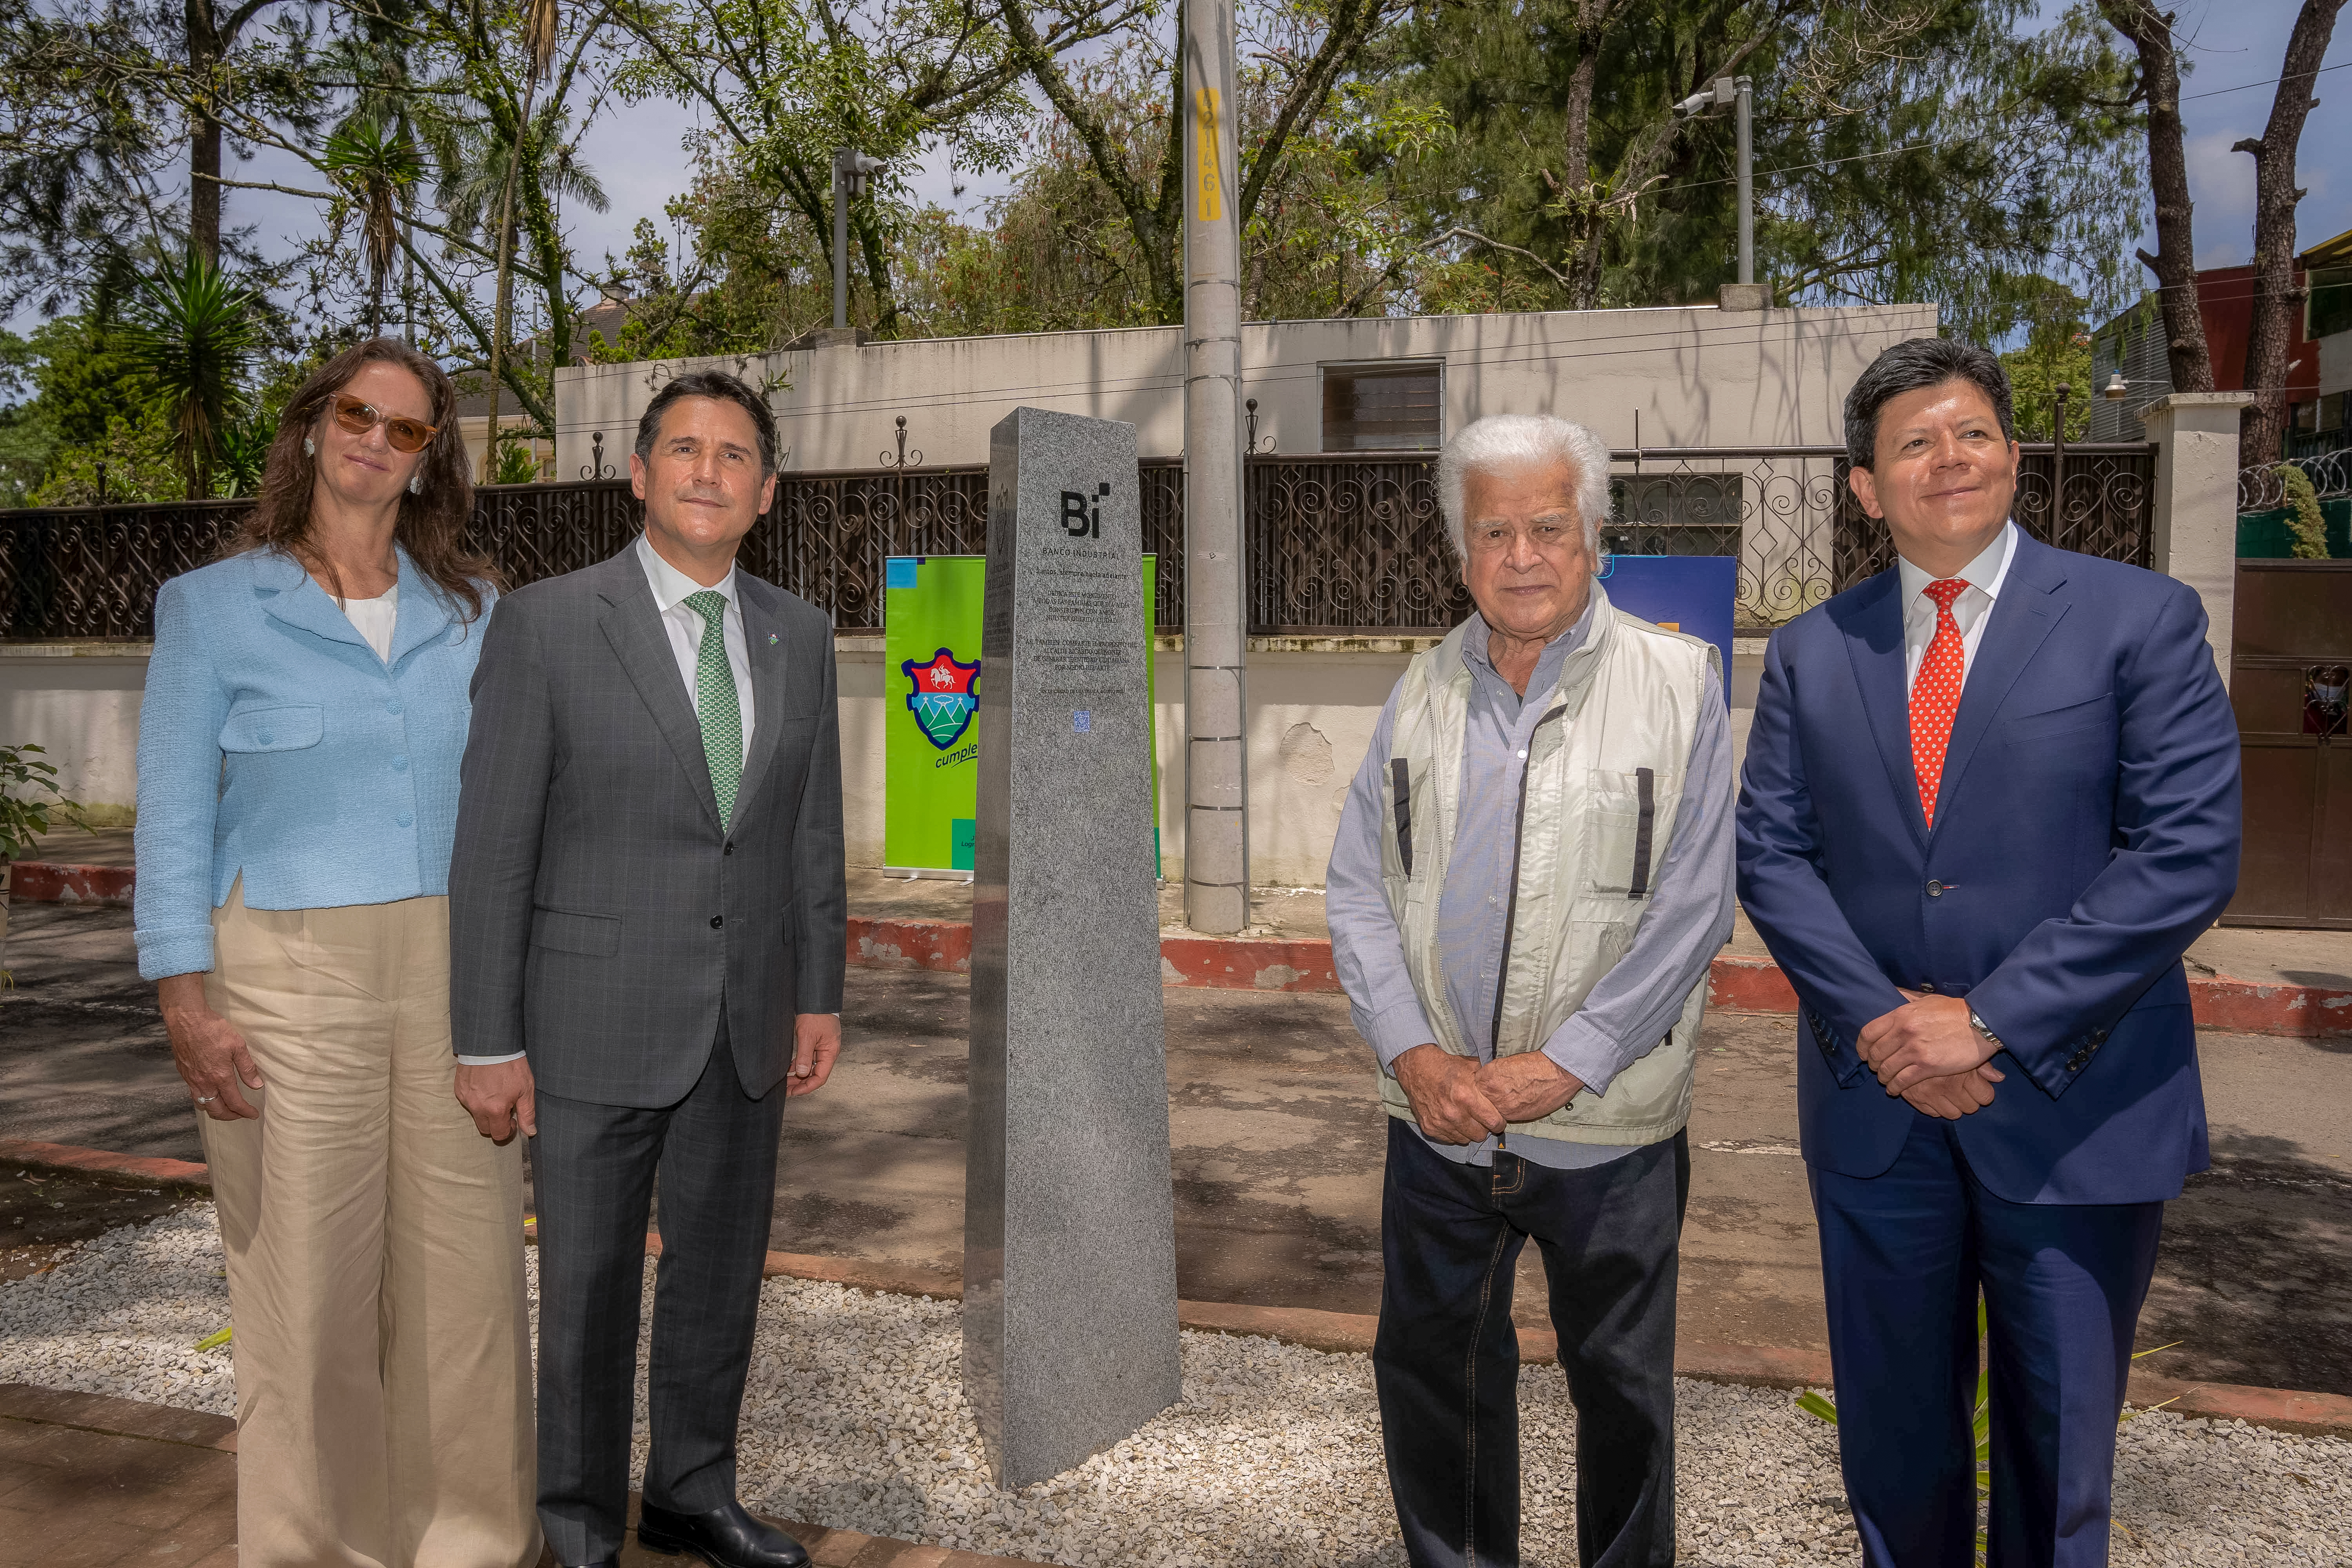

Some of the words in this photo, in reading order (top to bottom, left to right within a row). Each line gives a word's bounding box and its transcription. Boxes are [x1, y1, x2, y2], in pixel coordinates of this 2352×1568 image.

[1061, 490, 1100, 539] Bi
[1043, 547, 1070, 556] BANCO
[1073, 549, 1120, 559] INDUSTRIAL
[1060, 568, 1084, 577] siempre
[936, 743, 978, 768] cumple
